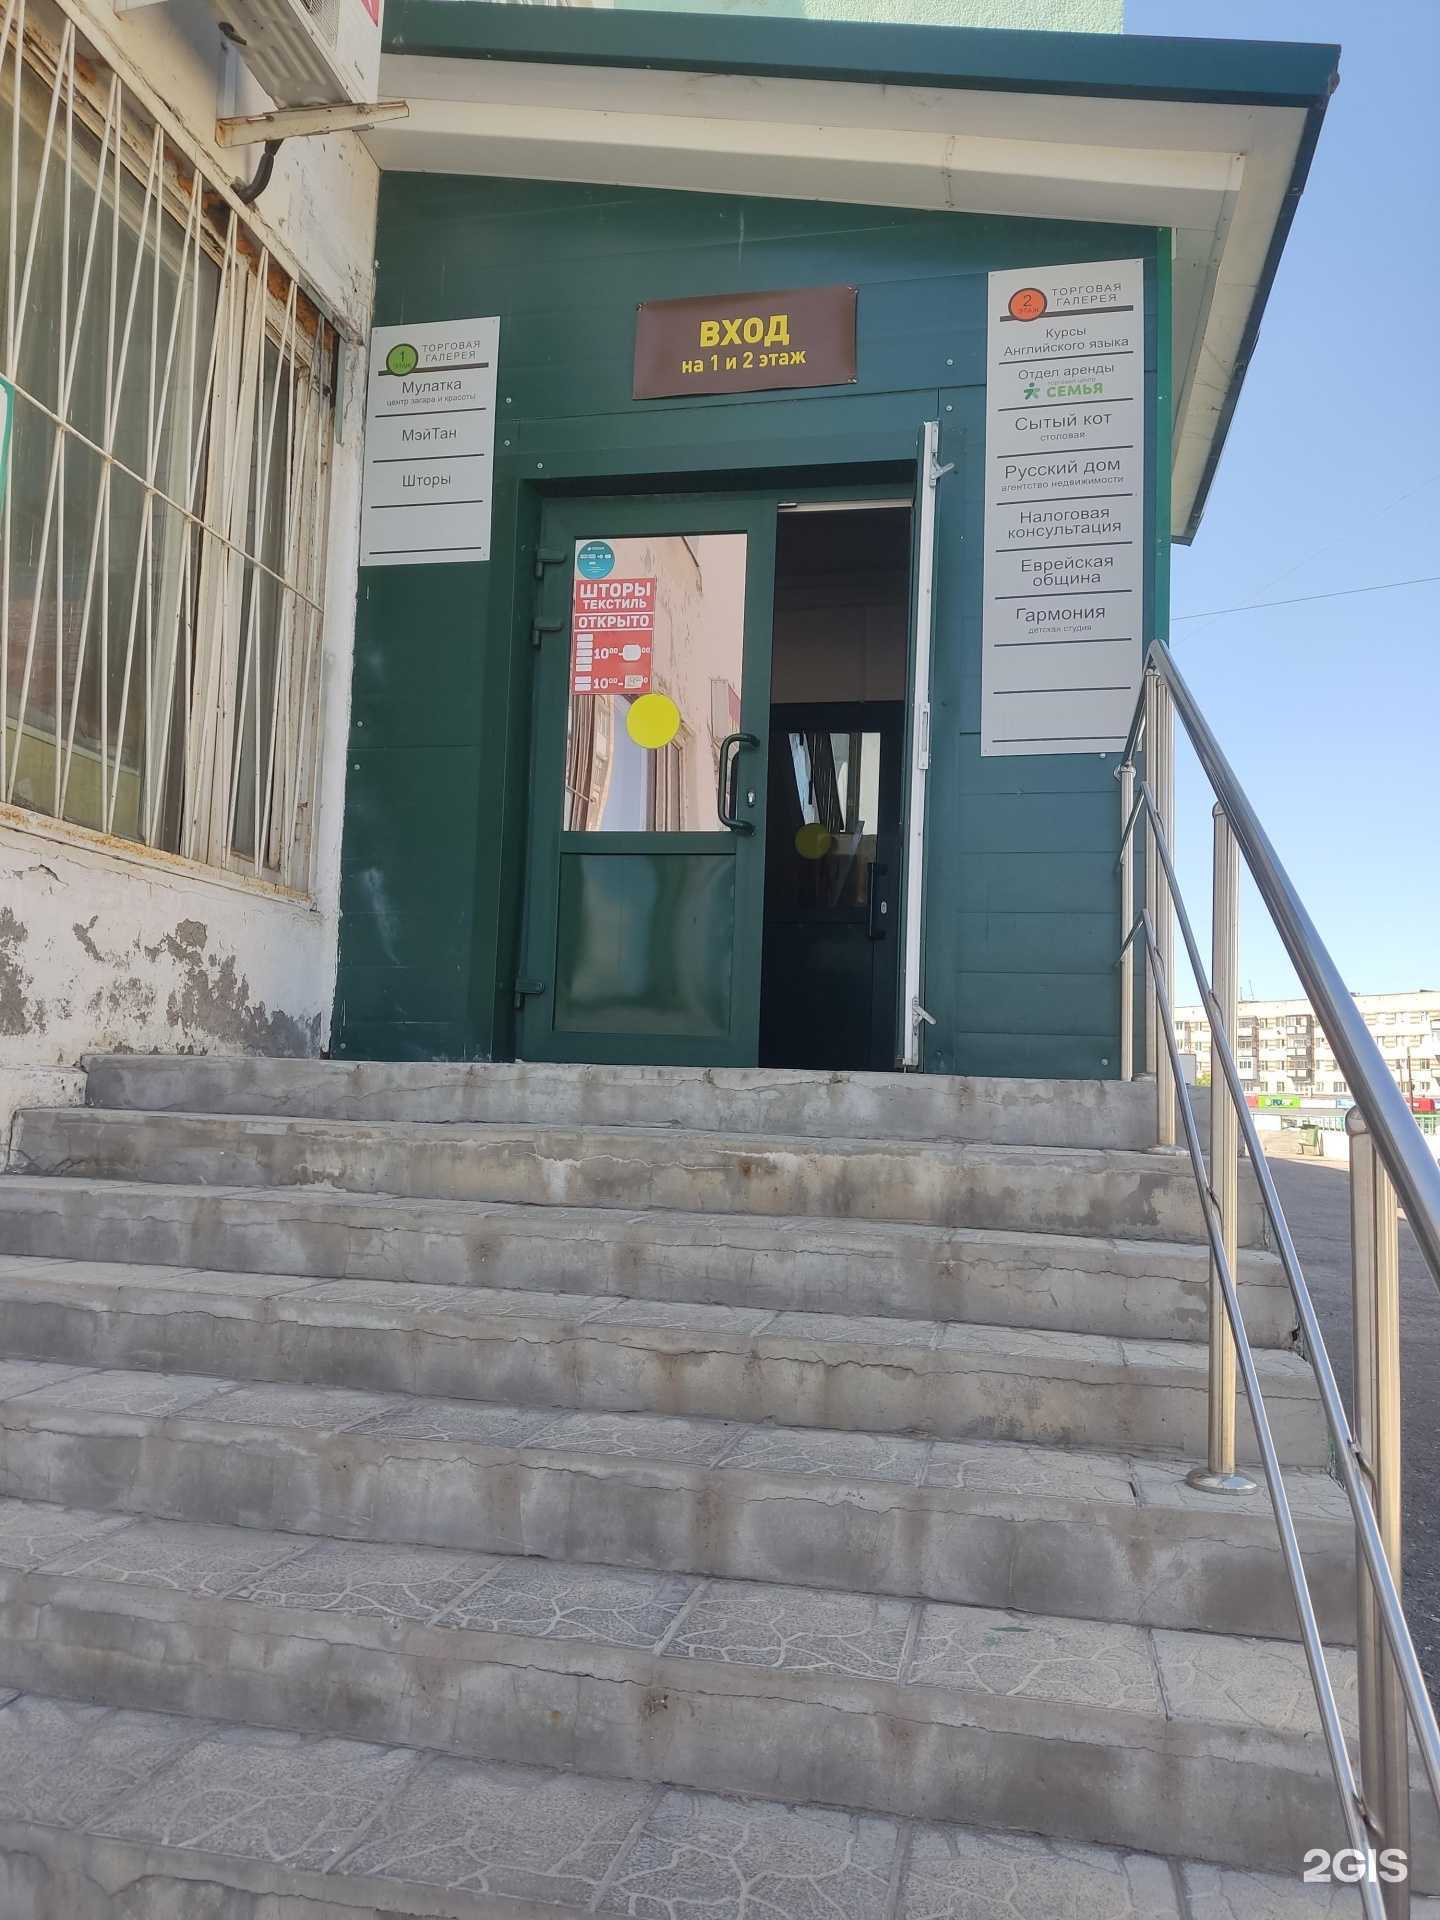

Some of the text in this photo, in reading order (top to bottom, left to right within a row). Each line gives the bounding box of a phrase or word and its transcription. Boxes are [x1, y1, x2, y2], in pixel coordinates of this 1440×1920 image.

[1051, 282, 1122, 296] ТОРГОВАЯ
[1023, 294, 1032, 307] 2
[1056, 293, 1117, 307] ГАЛЕРЕЯ
[700, 313, 790, 348] ВХОД
[1046, 327, 1087, 340] Курсы
[421, 340, 481, 353] ТОРГОВАЯ
[1004, 337, 1129, 357] Английского языка
[425, 350, 477, 363] ГАЛЕРЕЯ
[681, 350, 807, 374] на 1 и 2 этаж
[1018, 364, 1115, 381] Отдел аренды
[402, 380, 462, 396] Мулатка
[1046, 382, 1104, 398] СЕМЬЯ
[386, 398, 409, 408] центр
[444, 393, 477, 403] красоты
[1015, 412, 1113, 431] Сытый кот
[401, 427, 457, 442] МэйТан
[1040, 431, 1086, 442] столовая
[1004, 460, 1121, 481] Русский дом
[402, 473, 451, 488] Шторы
[1001, 475, 1125, 493] агентство недвижимости
[1020, 508, 1110, 524] Налоговая
[1008, 522, 1122, 540] консультация
[1021, 556, 1114, 574] Еврейская
[1032, 573, 1101, 587] община
[580, 582, 651, 598] ШТОРЫ
[583, 598, 647, 610] ТЕКСТИЛЬ
[578, 615, 650, 629] ОТКРЫТО
[1016, 607, 1106, 625] Гармония
